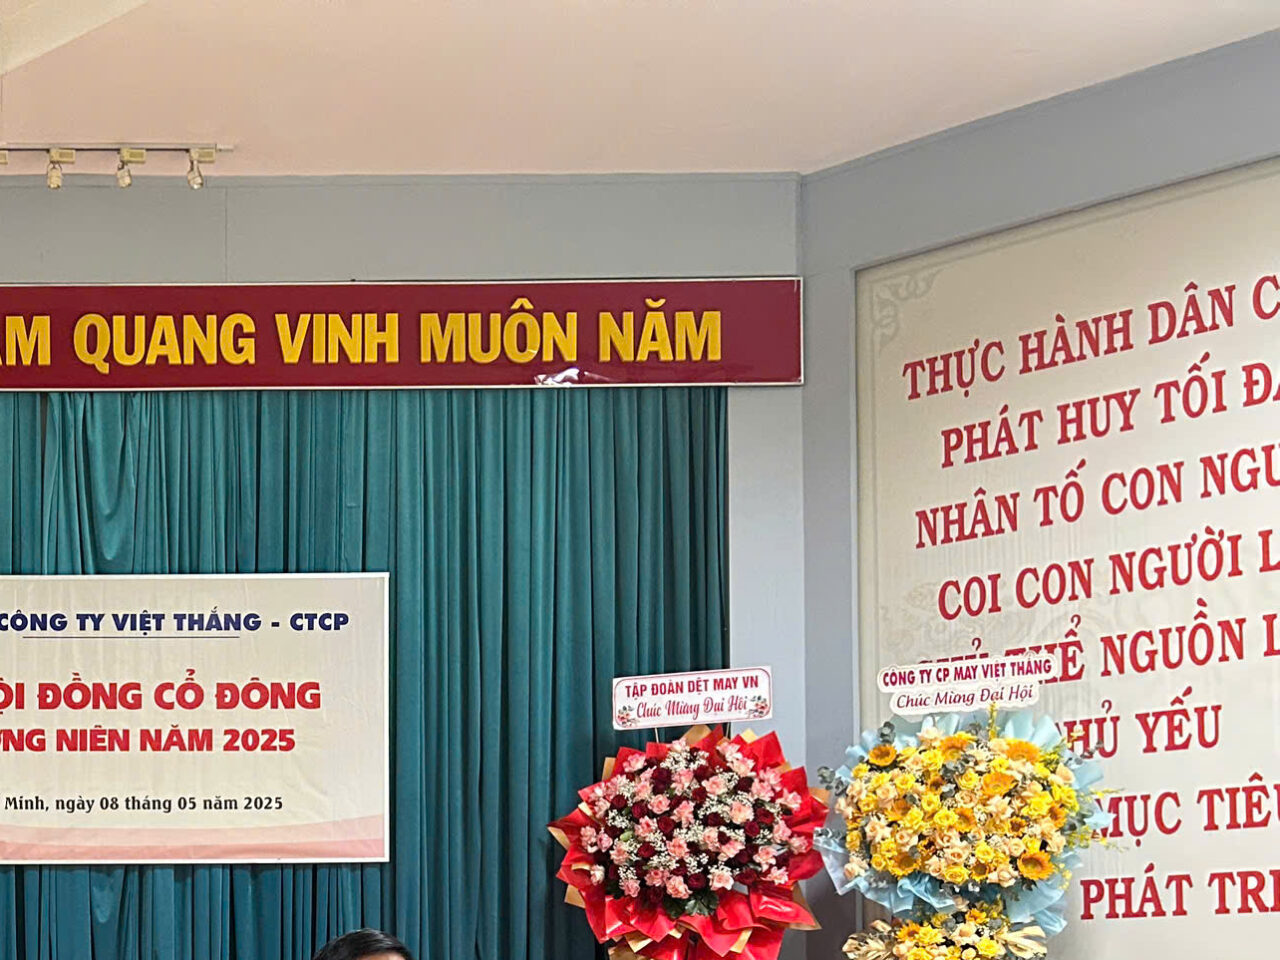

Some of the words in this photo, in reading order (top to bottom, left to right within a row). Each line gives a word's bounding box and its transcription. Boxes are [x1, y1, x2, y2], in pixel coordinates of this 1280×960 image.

[74, 313, 255, 373] QUANG
[275, 313, 398, 364] VINH
[421, 298, 577, 363] MUÔN
[599, 299, 721, 362] NĂM
[903, 339, 1004, 400] THỰC
[1019, 310, 1133, 374] HÀNH
[1148, 282, 1235, 344] DÂN
[942, 405, 1043, 468] PHÁT
[1057, 389, 1140, 444] HUY
[1155, 352, 1226, 423] TỐI
[1242, 363, 1280, 406] Đ
[916, 488, 1019, 548] NHÂN
[1034, 459, 1086, 526] TỐ
[1102, 462, 1184, 514] CON
[939, 574, 1001, 620] COI
[1016, 559, 1094, 608] CON
[1109, 526, 1242, 594] NGƯỜI
[76, 613, 105, 631] TY
[111, 609, 166, 636] VIỆT
[173, 606, 262, 631] THẮNG
[289, 612, 349, 631] CTCP
[1101, 598, 1246, 676] NGUỒN
[38, 673, 142, 710] ĐỒNG
[155, 669, 204, 710] CỔ
[215, 678, 320, 709] ĐÔNG
[625, 682, 648, 700] TẬP
[651, 679, 684, 696] ĐOÀN
[688, 677, 709, 696] DỆT
[713, 677, 738, 691] MAY
[742, 675, 759, 688] VN
[883, 669, 916, 687] CÔNG
[919, 669, 932, 684] TY
[936, 668, 950, 683] CP
[954, 665, 979, 681] MAY
[981, 660, 1007, 682] VIỆT
[1011, 655, 1052, 678] THẮNG
[636, 702, 662, 718] Chúc
[703, 696, 724, 716] Đại
[728, 695, 748, 714] Hội
[897, 693, 931, 709] Chúc
[980, 687, 1004, 703] Đại
[1009, 685, 1034, 702] Hội
[57, 726, 129, 751] NIÊN
[140, 725, 212, 751] NĂM
[224, 729, 295, 751] 2025
[1056, 700, 1120, 759] HỦ
[1136, 687, 1221, 753] YẾU
[4, 795, 49, 812] Minh,
[55, 795, 95, 814] ngày
[99, 797, 119, 810] 08
[124, 795, 172, 814] tháng
[177, 796, 197, 810] 05
[203, 796, 238, 810] năm
[243, 796, 283, 810] 2025
[1081, 864, 1192, 919] PHÁT
